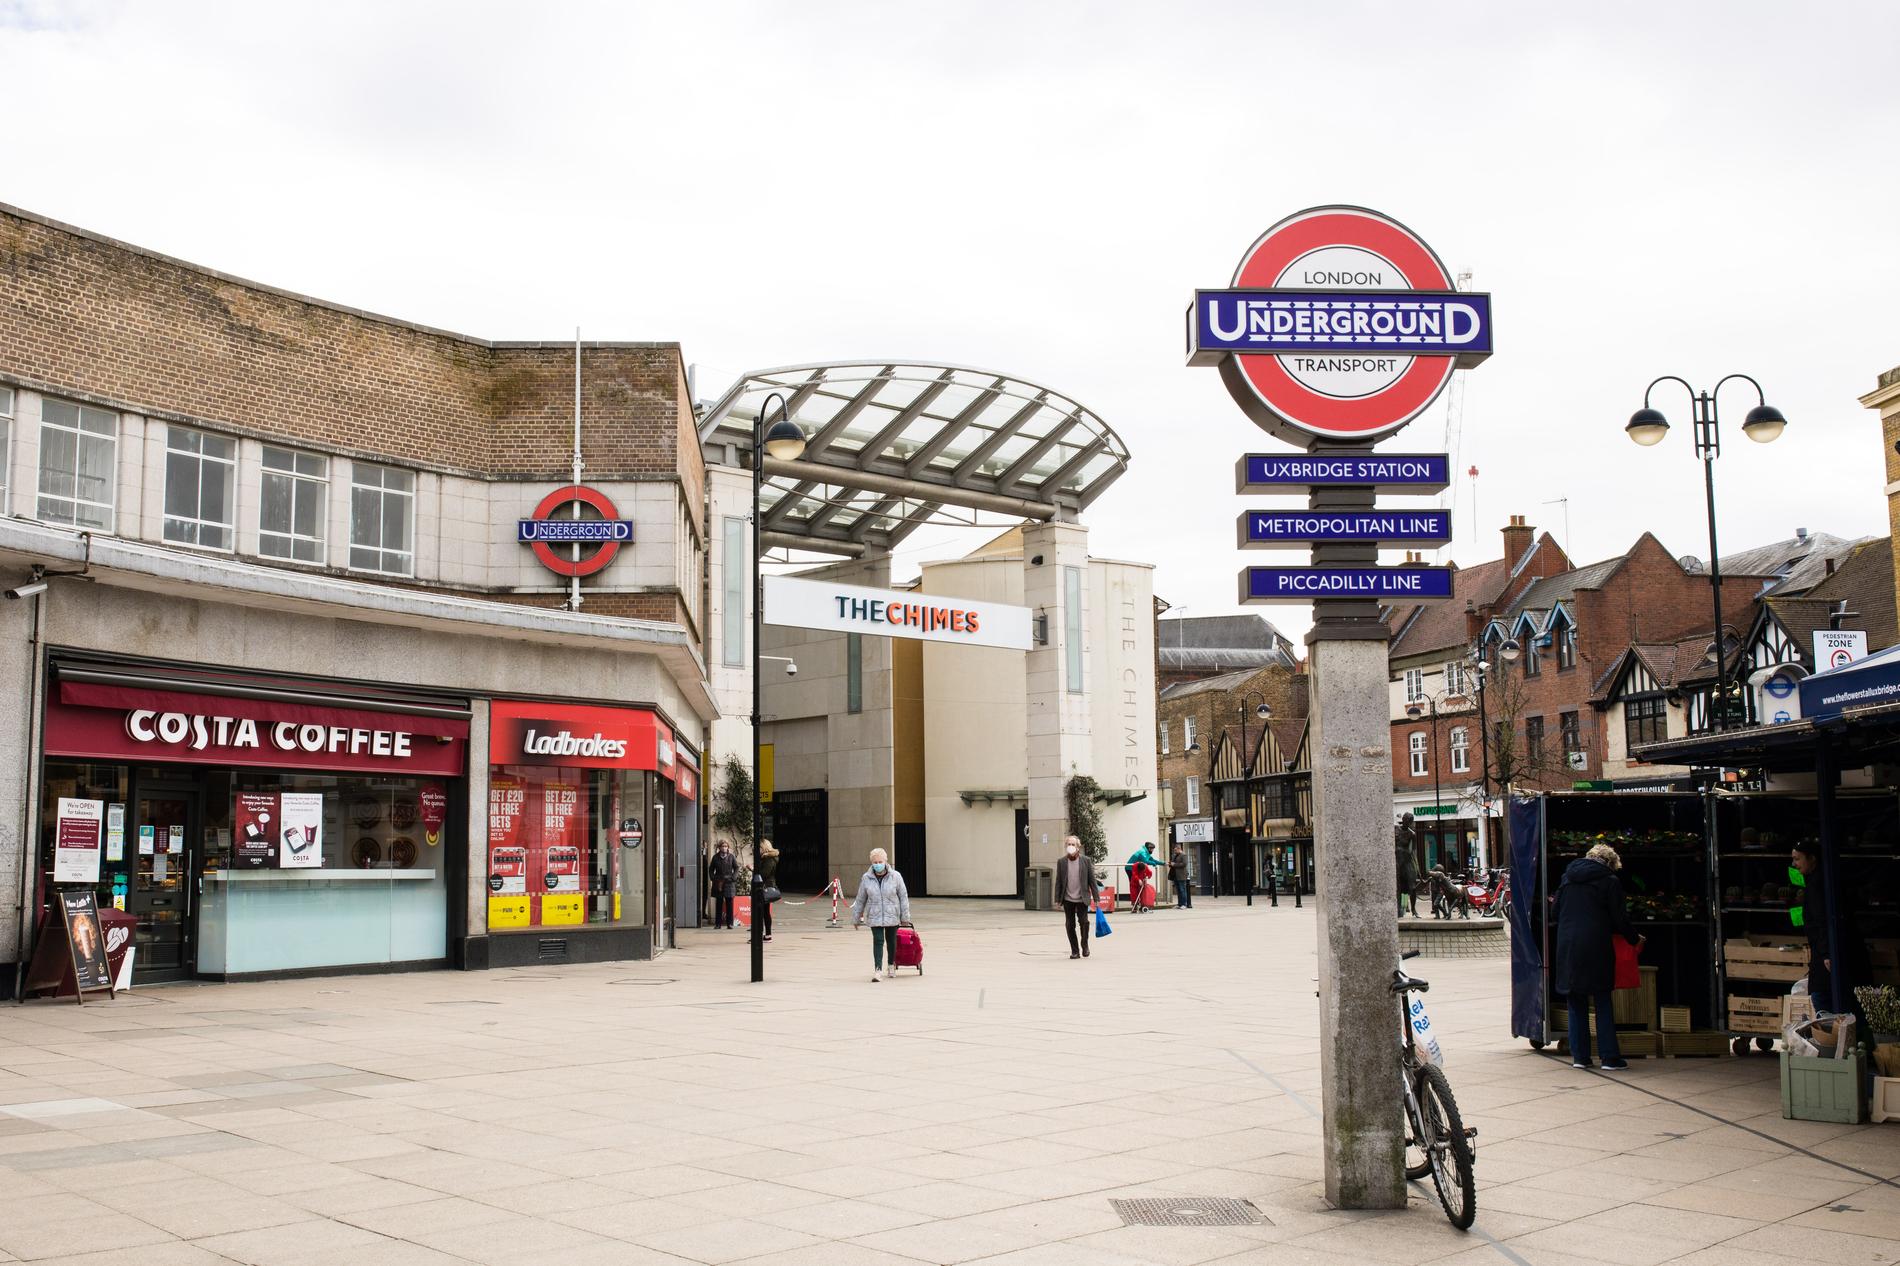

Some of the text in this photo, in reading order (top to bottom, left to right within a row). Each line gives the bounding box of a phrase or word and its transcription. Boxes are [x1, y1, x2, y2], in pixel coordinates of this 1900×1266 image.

[1304, 271, 1382, 286] LONDON
[1208, 299, 1481, 344] UNDERGROUND
[1294, 357, 1397, 374] TRANSPORT
[1263, 462, 1431, 478] UXBRIDGE STATION
[522, 522, 629, 539] UNDERGROUND
[1257, 518, 1439, 534] METROPOLITAN LINE
[1278, 574, 1422, 591] PICCADILLY LINE
[1827, 639, 1853, 648] ZONE
[1122, 599, 1139, 788] THE CHIMES
[127, 709, 412, 757] COSTA COFFEE
[524, 729, 628, 758] Ladbrokes
[491, 790, 523, 803] GET £20
[545, 790, 577, 803] GET £20
[74, 810, 93, 818] takeaway
[490, 803, 520, 815] IN FREE
[545, 803, 573, 815] IN FREE
[490, 815, 511, 828] BETS
[545, 815, 564, 828] BETS
[1183, 823, 1206, 837] SIMPLY
